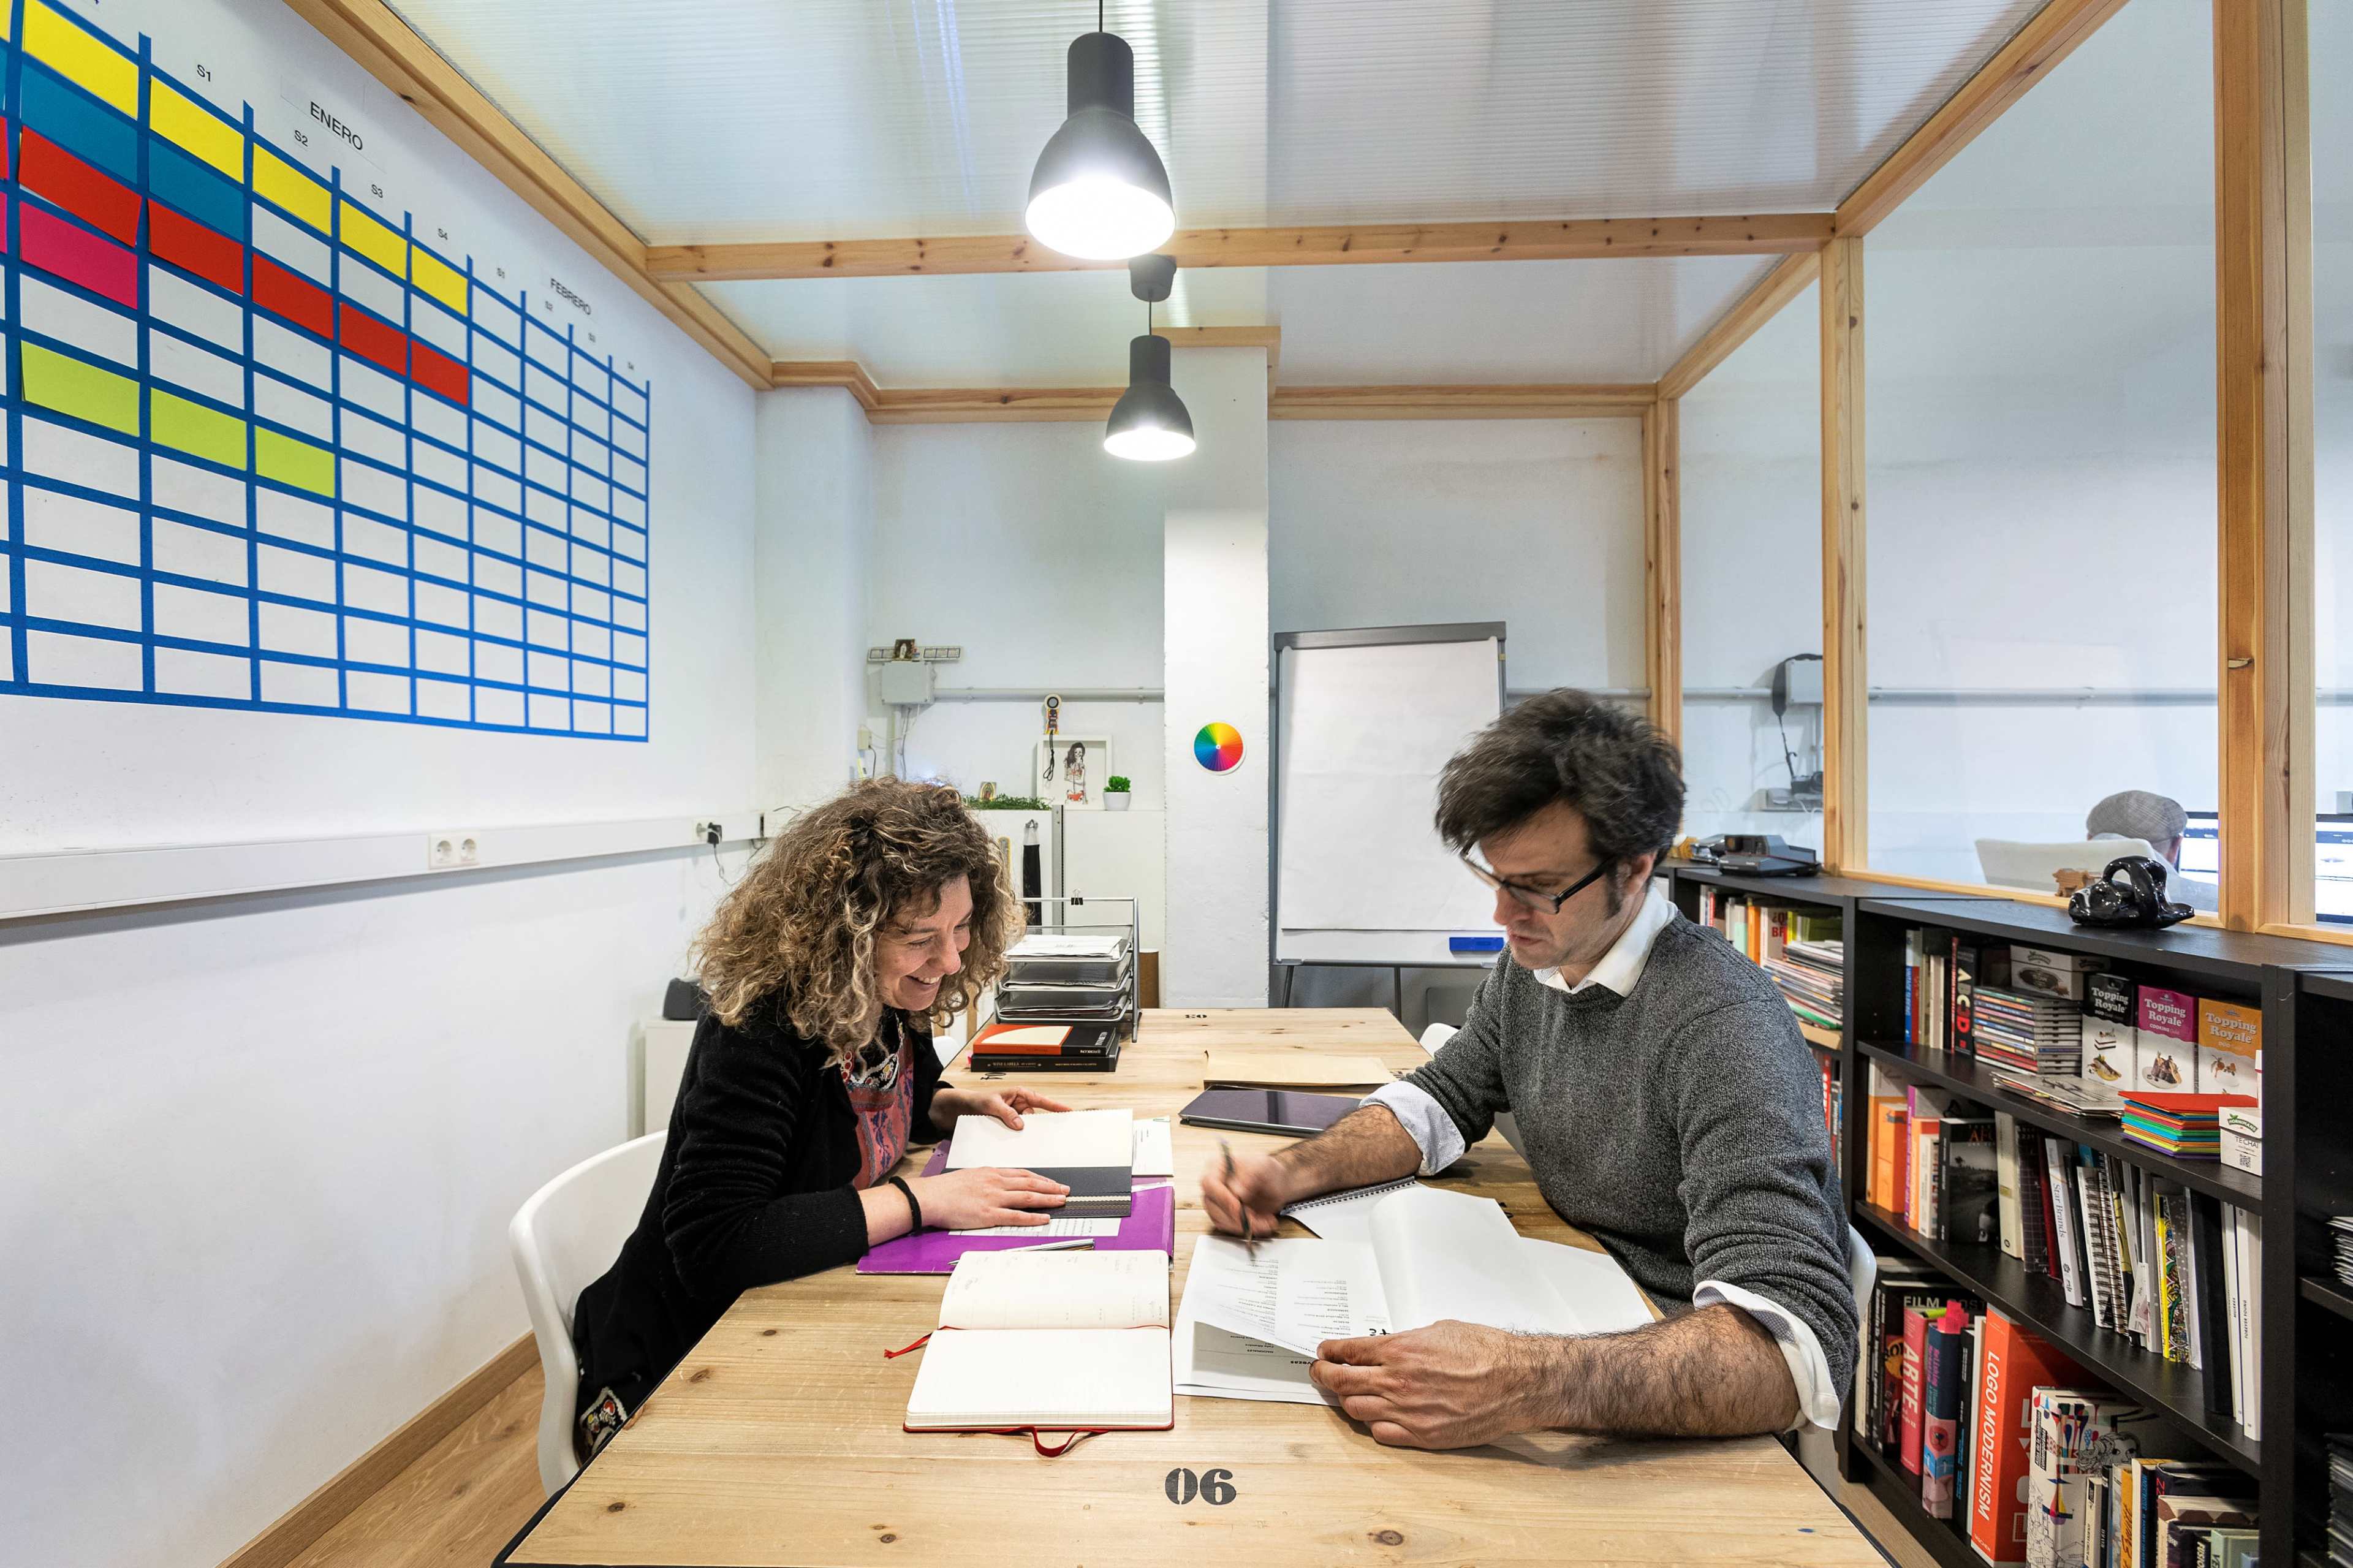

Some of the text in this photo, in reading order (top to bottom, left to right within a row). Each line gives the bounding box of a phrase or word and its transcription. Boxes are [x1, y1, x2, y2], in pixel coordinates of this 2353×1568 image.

[197, 64, 211, 82] S1
[311, 101, 363, 150] ENERO
[294, 130, 308, 146] S2
[371, 184, 383, 199] S3
[438, 227, 448, 241] S4
[551, 278, 591, 315] FEBRERO
[2091, 987, 2129, 1004] Topping
[2094, 999, 2126, 1013] Royale
[2145, 998, 2186, 1018] Topping
[2148, 1010, 2182, 1027] Royale
[2150, 1023, 2170, 1032] COOKING
[2206, 1012, 2257, 1034] Topping
[2211, 1025, 2251, 1043] Royale
[2052, 1183, 2067, 1237] Star Brands
[1904, 1295, 1939, 1308] FILM
[1902, 1342, 1920, 1414] ARTE
[1978, 1350, 2001, 1521] LOGO MODERNISM
[1165, 1468, 1237, 1505] 06
[2196, 1542, 2205, 1568] FUSIO
